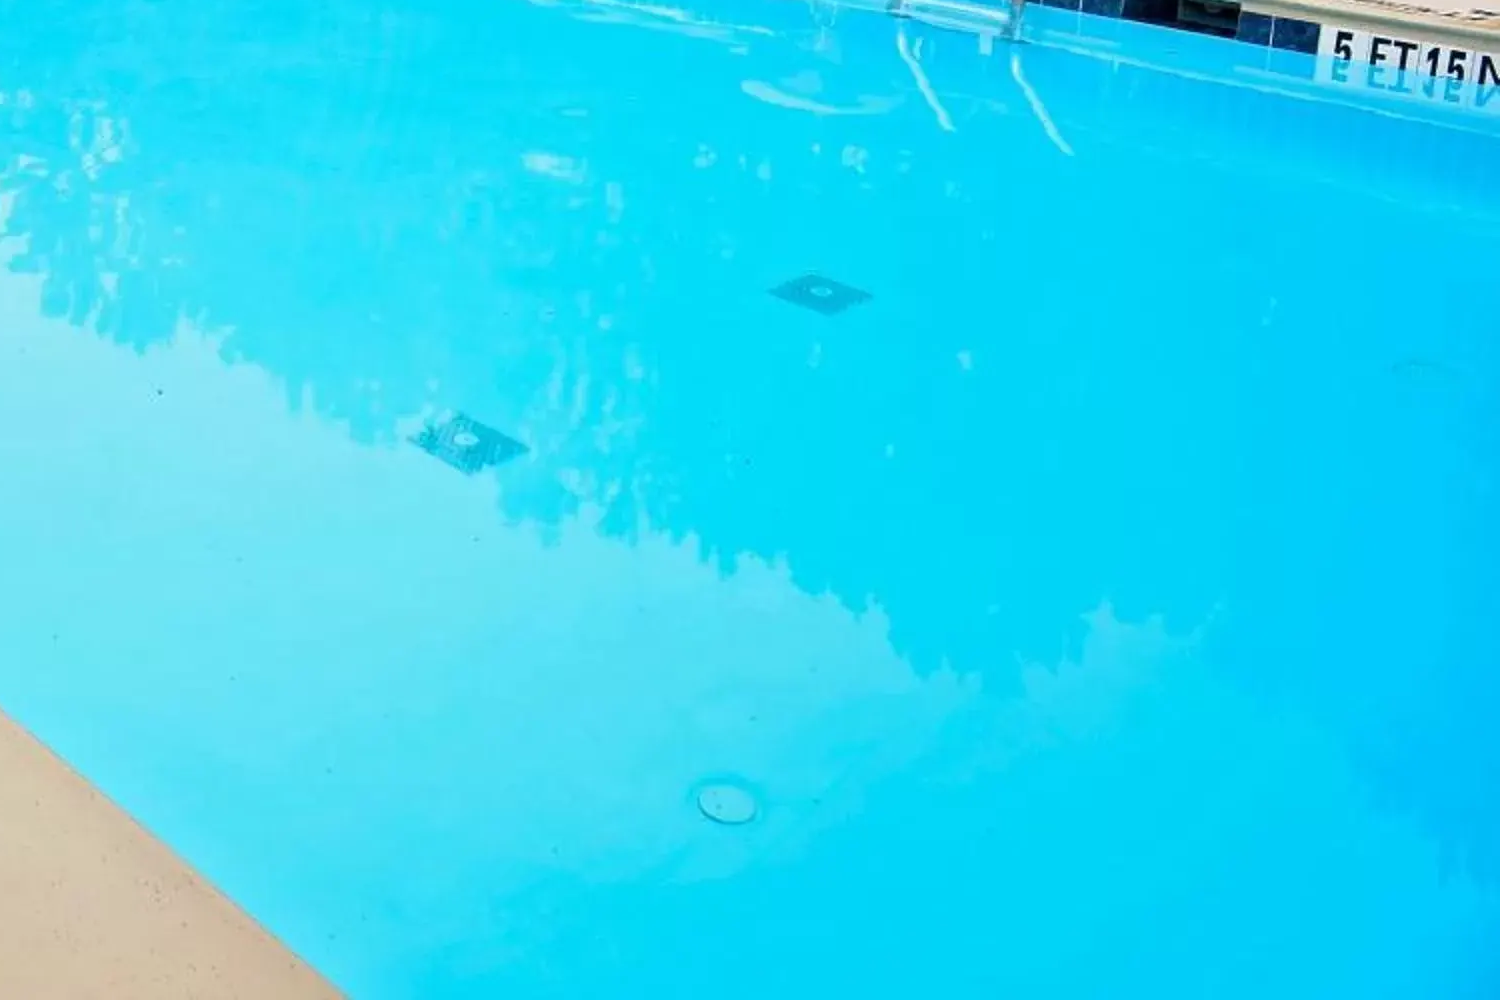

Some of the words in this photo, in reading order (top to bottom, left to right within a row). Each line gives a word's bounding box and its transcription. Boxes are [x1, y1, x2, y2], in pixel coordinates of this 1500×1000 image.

[1334, 30, 1353, 61] 5
[1369, 37, 1419, 71] FT
[1426, 46, 1467, 81] 15
